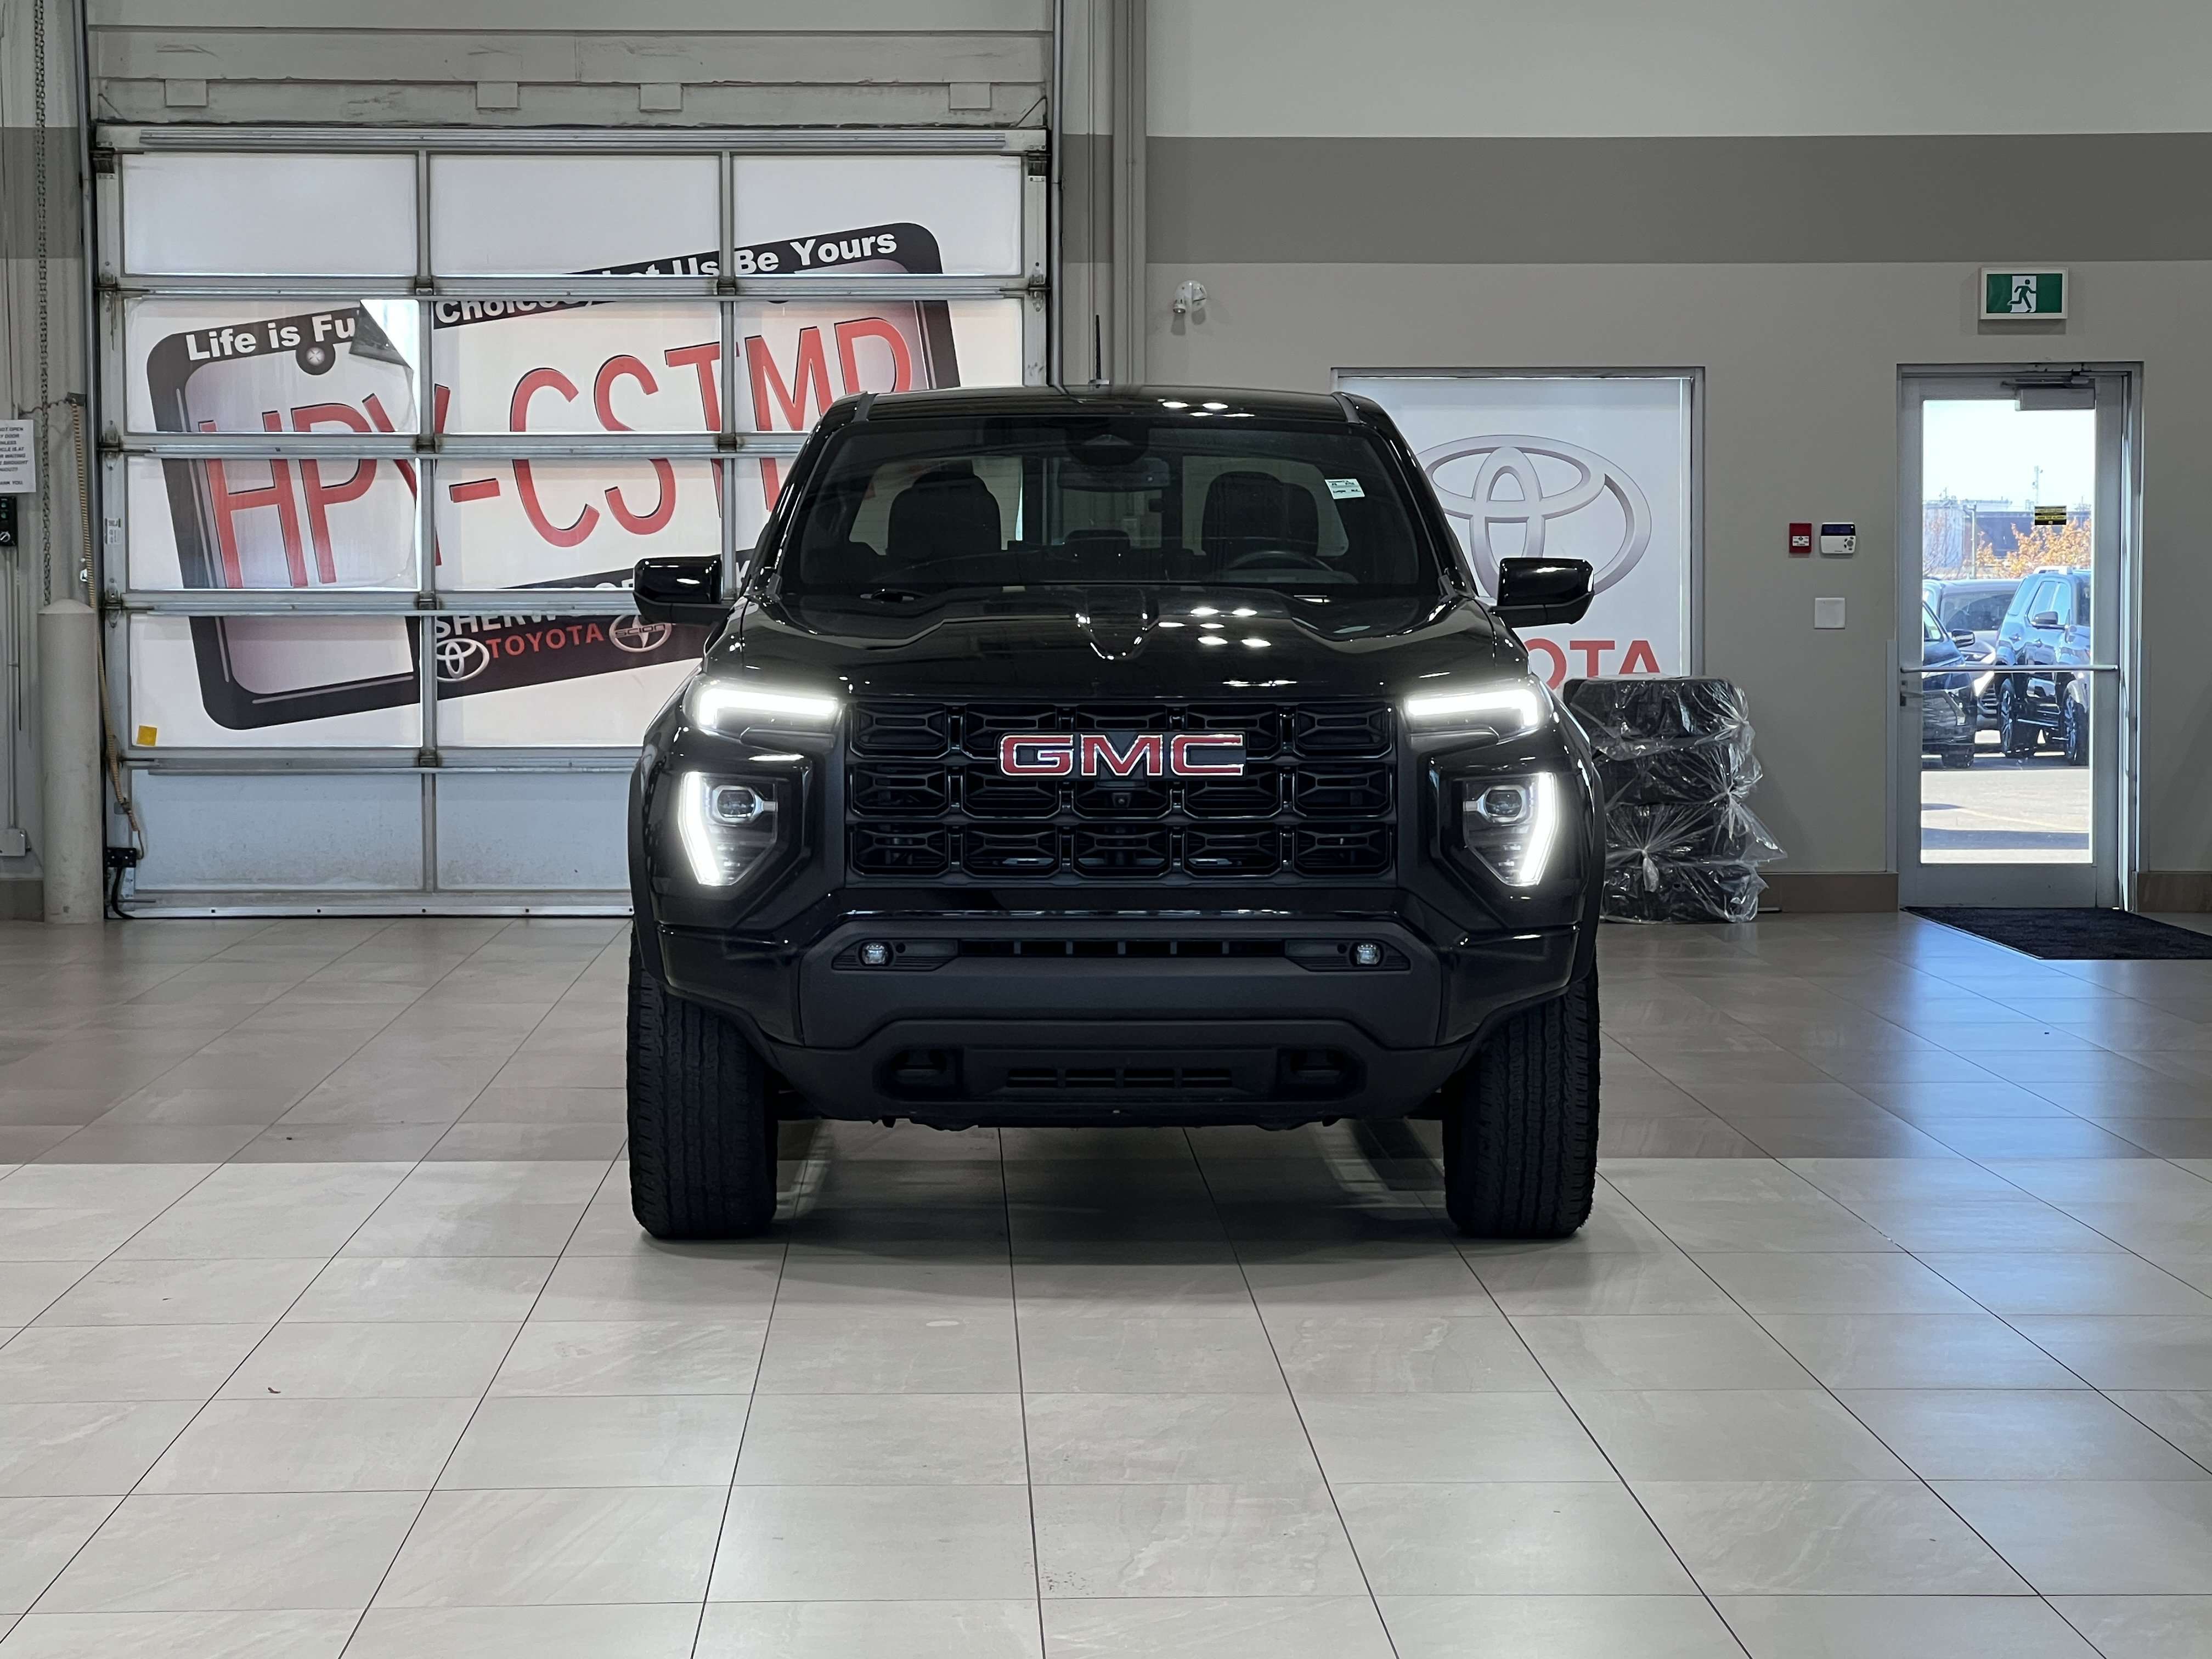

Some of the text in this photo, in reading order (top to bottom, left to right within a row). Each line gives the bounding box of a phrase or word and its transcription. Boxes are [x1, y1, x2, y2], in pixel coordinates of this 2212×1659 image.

[186, 329, 256, 361] Life
[269, 323, 300, 348] is
[312, 309, 360, 342] Fu
[735, 250, 778, 274] Be
[791, 232, 897, 266] Yours
[486, 623, 604, 658] TOYOTA
[1524, 637, 1661, 690] OTA
[1000, 734, 1244, 776] GMC
